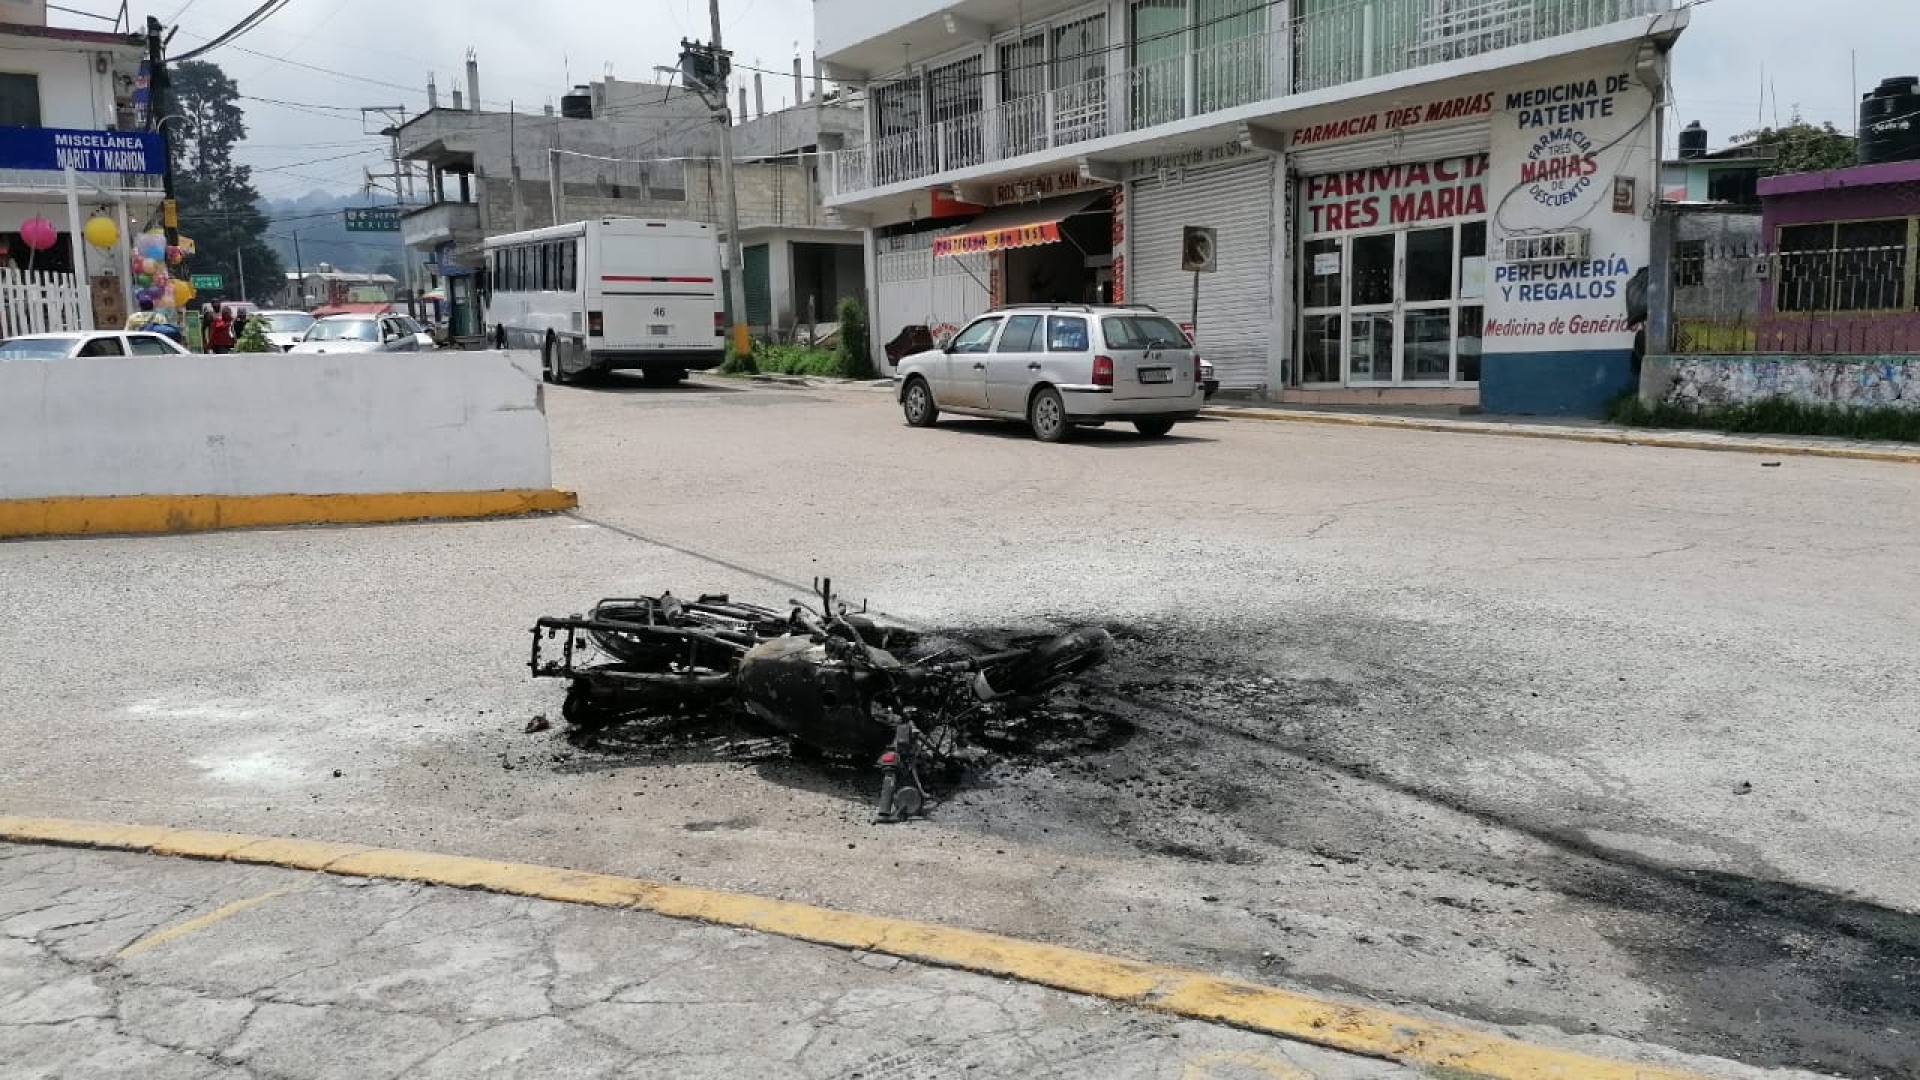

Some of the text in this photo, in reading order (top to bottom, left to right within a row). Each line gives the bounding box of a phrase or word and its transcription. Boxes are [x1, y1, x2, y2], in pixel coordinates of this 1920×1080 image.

[1506, 73, 1630, 110] MEDICINA DE
[1292, 91, 1495, 145] FARMACIA TRES MARIAS
[1518, 97, 1614, 129] PATENTE
[1528, 128, 1592, 161] FARMACIA
[1547, 143, 1572, 155] TRES
[56, 149, 147, 172] MARIT Y MARION
[1520, 152, 1598, 184] MARIAS
[1529, 176, 1592, 207] DESCUENTO
[1551, 181, 1565, 191] DE
[1308, 183, 1487, 233] TRES MARIA
[1494, 252, 1630, 283] PERFUMERÍA
[1502, 280, 1617, 303] Y REGALOS
[653, 305, 666, 319] 46
[1485, 317, 1546, 337] Medicina
[1549, 317, 1566, 336] de
